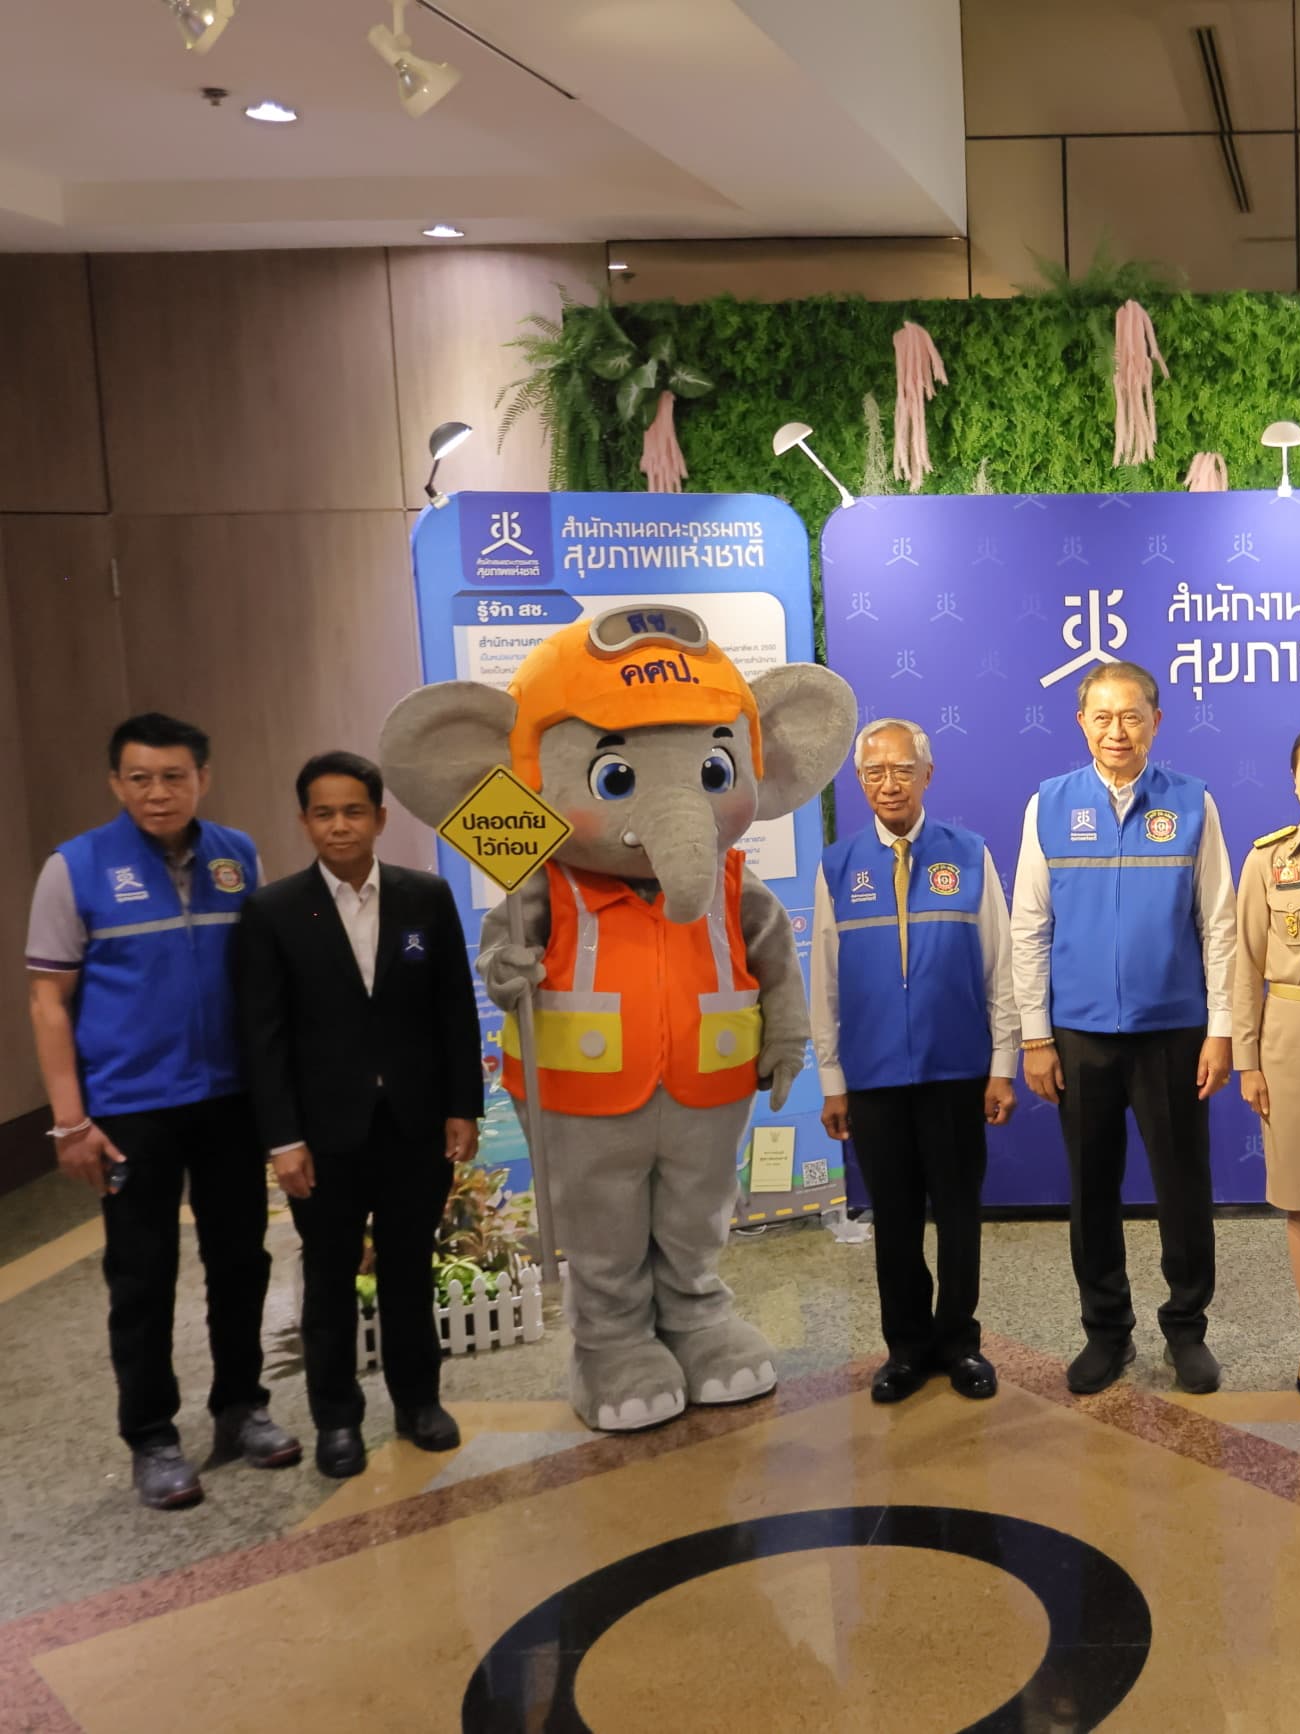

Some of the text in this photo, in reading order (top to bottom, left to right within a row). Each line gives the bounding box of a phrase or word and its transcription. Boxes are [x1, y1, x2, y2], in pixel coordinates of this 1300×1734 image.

[562, 515, 763, 538] สำนักงานคณะกรรมการ
[564, 538, 764, 579] สุขภาพแห่งชาติ
[476, 600, 549, 622] รู้จัก สช.
[620, 653, 700, 687] คศป.
[462, 810, 546, 831] ปลอดภัย
[471, 836, 539, 857] ไว้ก่อน
